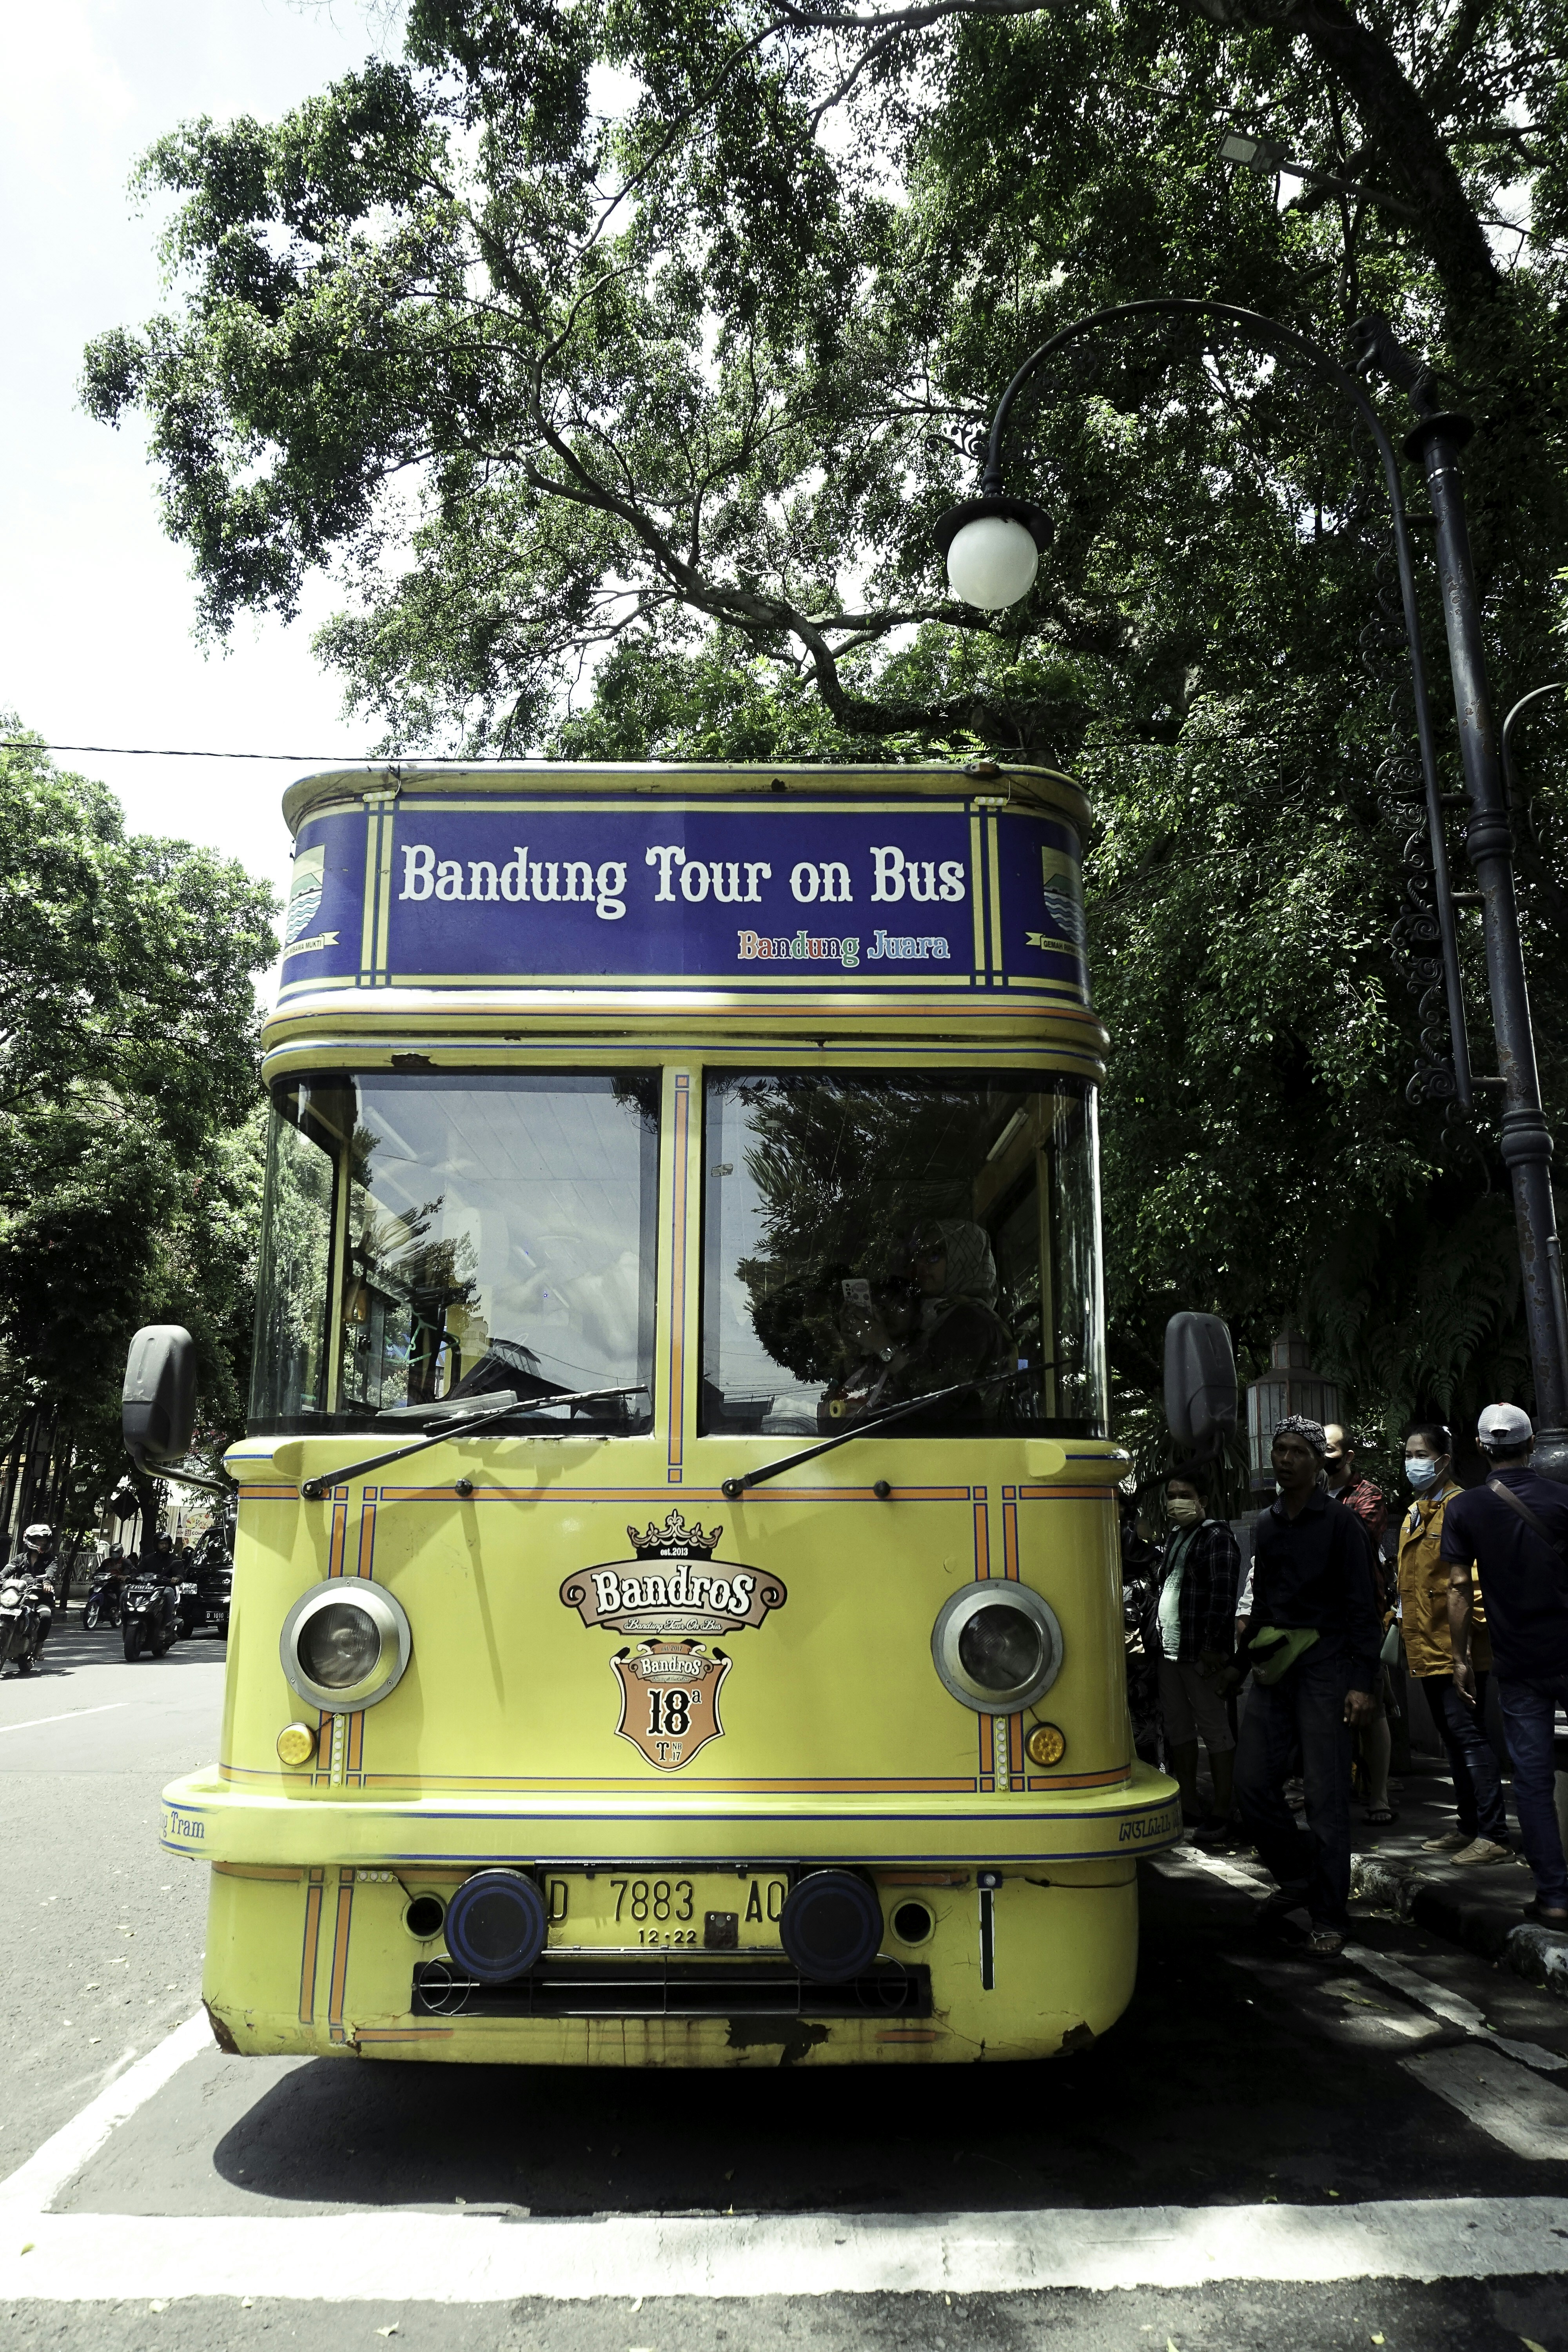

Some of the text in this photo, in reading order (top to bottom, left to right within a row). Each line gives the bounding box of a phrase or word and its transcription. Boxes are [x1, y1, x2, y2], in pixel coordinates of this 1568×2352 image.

[399, 845, 965, 920] Bandung Tour on Bus
[305, 940, 321, 949] MUKTI
[738, 930, 950, 967] Bandung Juara
[592, 1565, 756, 1616] Bandros
[624, 1617, 722, 1634] Bandung Tour On Bus
[640, 1656, 702, 1676] Bandros
[171, 1811, 205, 1838] Tram
[550, 1880, 568, 1921] D
[610, 1880, 693, 1921] 7883
